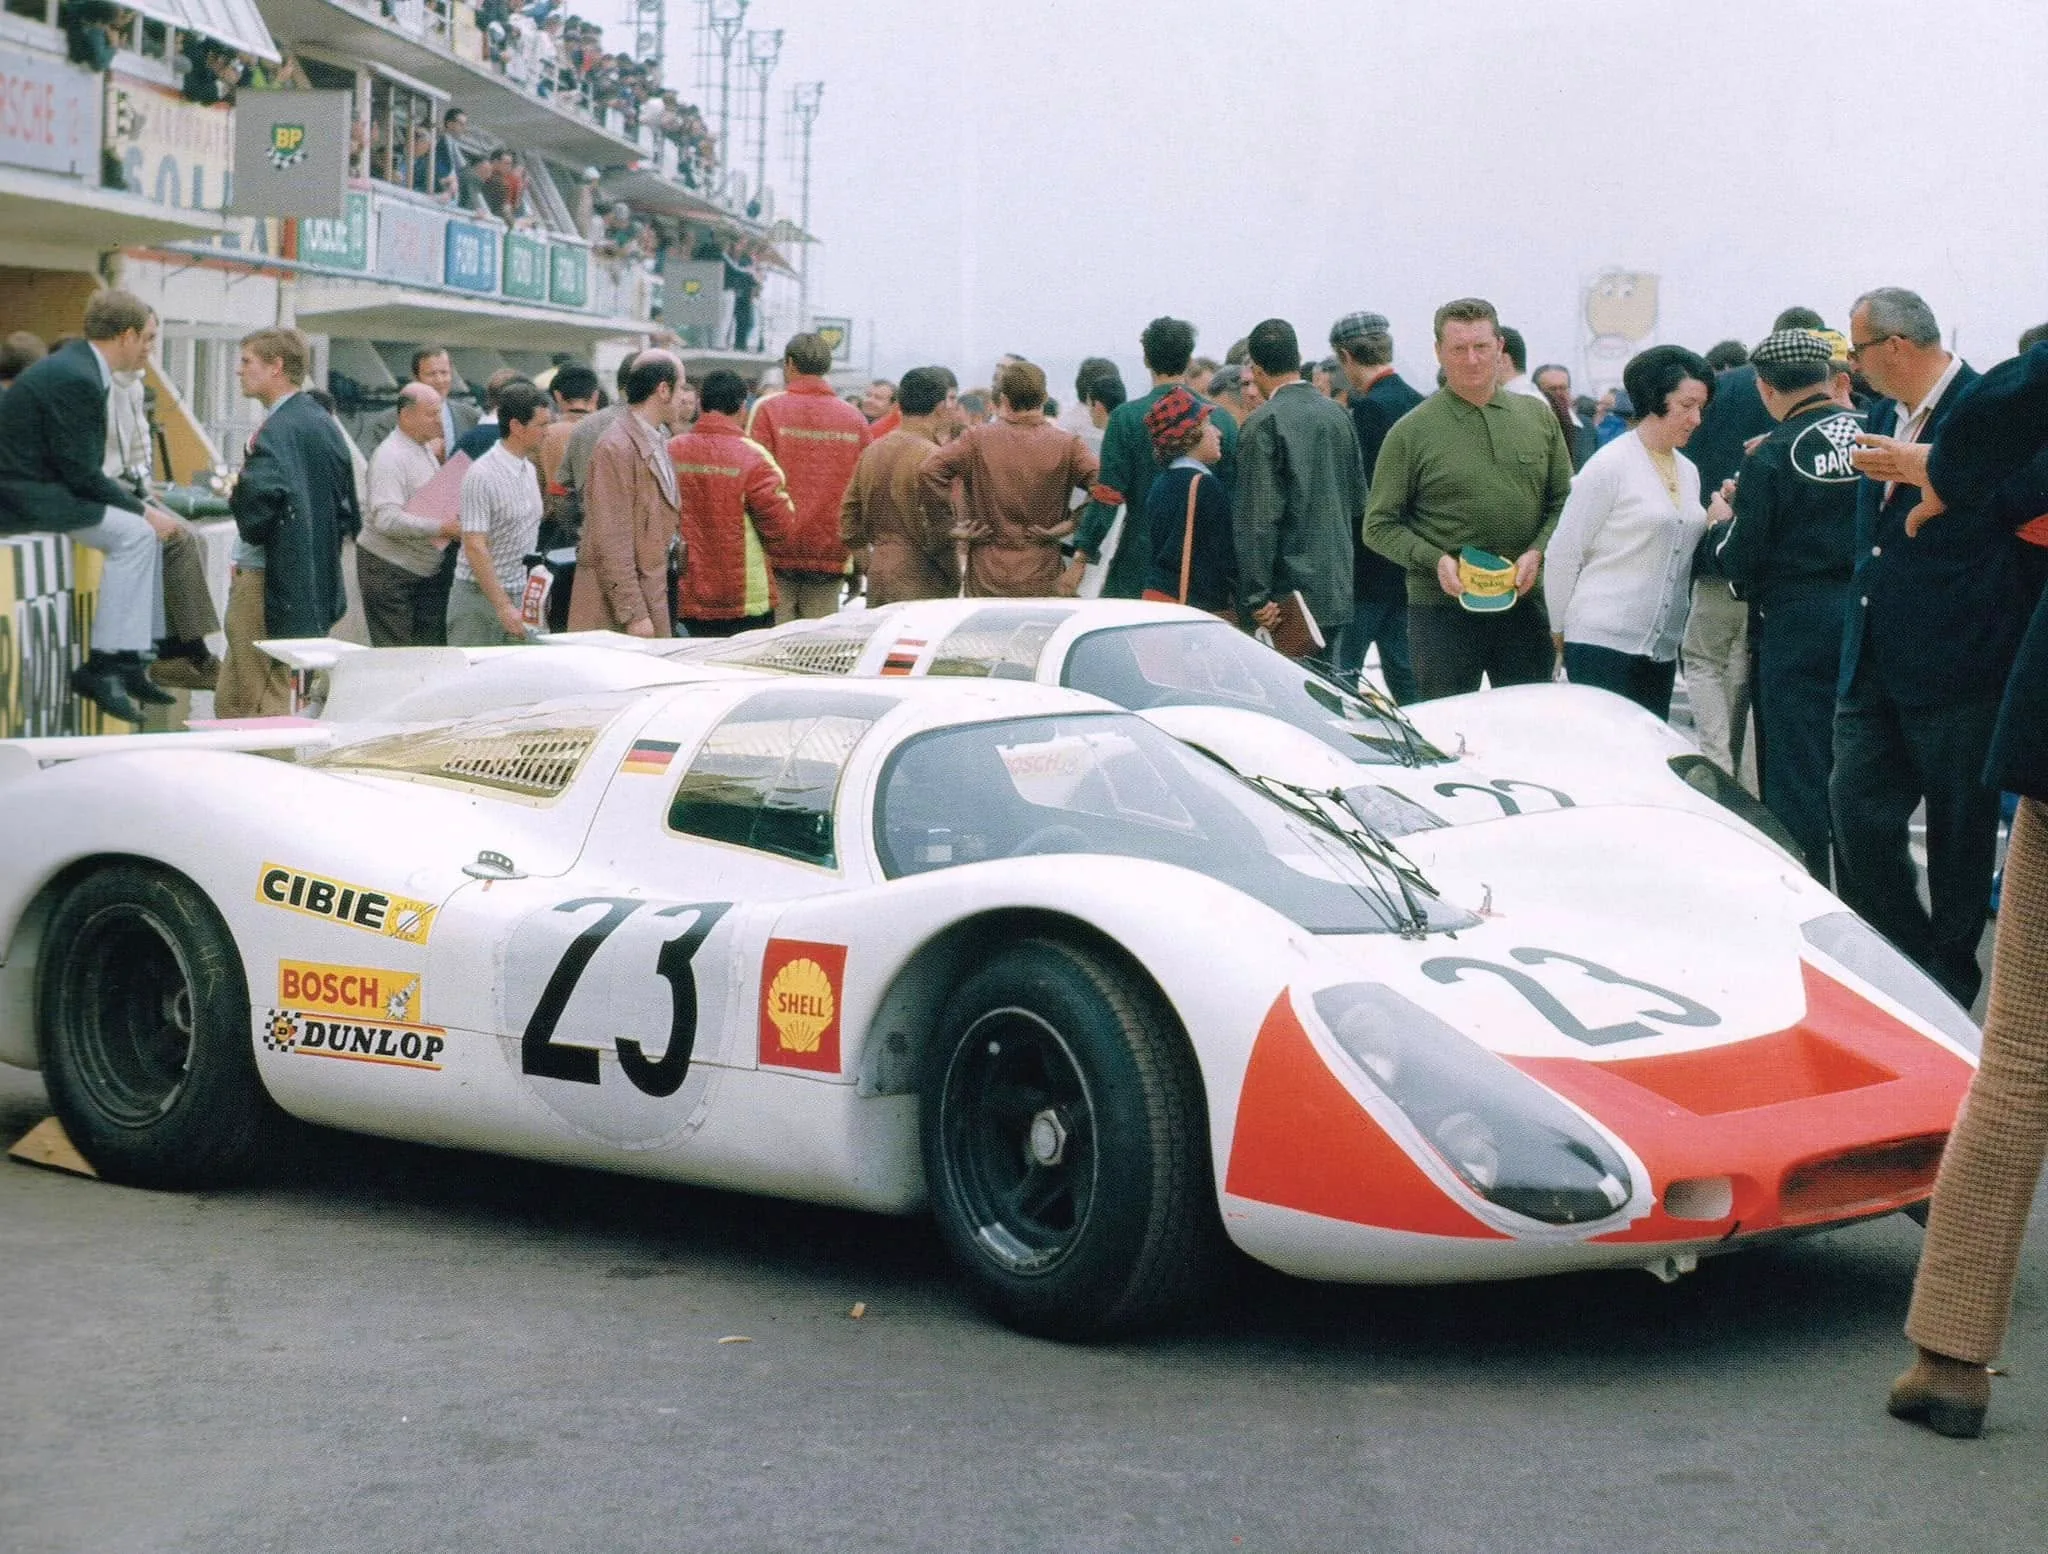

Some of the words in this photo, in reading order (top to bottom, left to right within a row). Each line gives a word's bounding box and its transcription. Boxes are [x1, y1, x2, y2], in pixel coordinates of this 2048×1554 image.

[276, 127, 303, 149] BP
[283, 968, 379, 1008] BOSCH
[521, 896, 734, 1098] 23
[778, 992, 825, 1018] SHELL
[1420, 947, 1722, 1046] 23
[301, 1021, 444, 1062] DUNLOP
